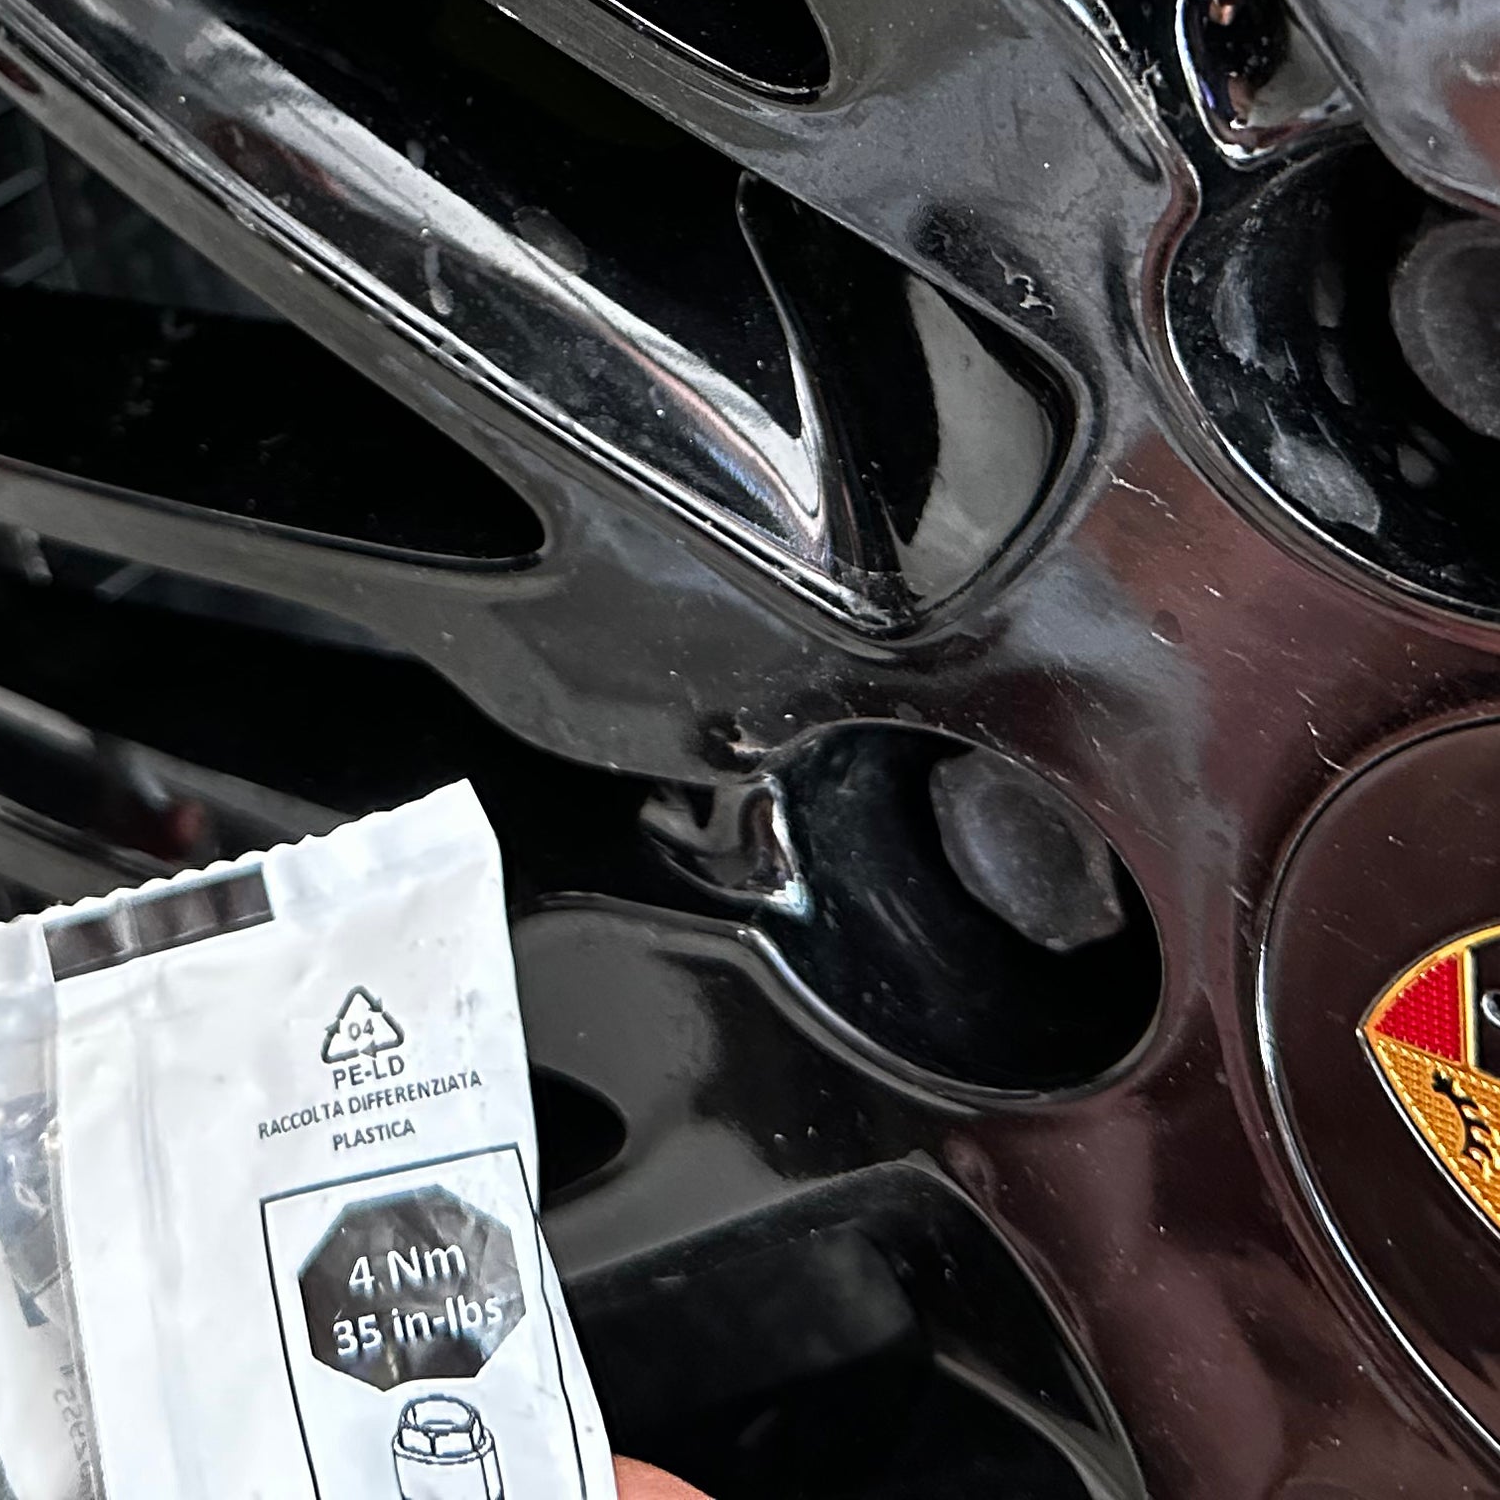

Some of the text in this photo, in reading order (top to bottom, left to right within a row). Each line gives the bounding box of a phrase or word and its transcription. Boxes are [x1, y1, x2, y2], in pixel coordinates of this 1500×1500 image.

[347, 1018, 376, 1042] 04
[332, 1054, 405, 1090] PE-LD
[258, 1070, 483, 1140] RACCOLTA DIFFERENZIATA
[332, 1118, 417, 1151] PLASTICA
[348, 1243, 468, 1297] 4 Nm
[332, 1294, 505, 1356] 35 in-lbs
